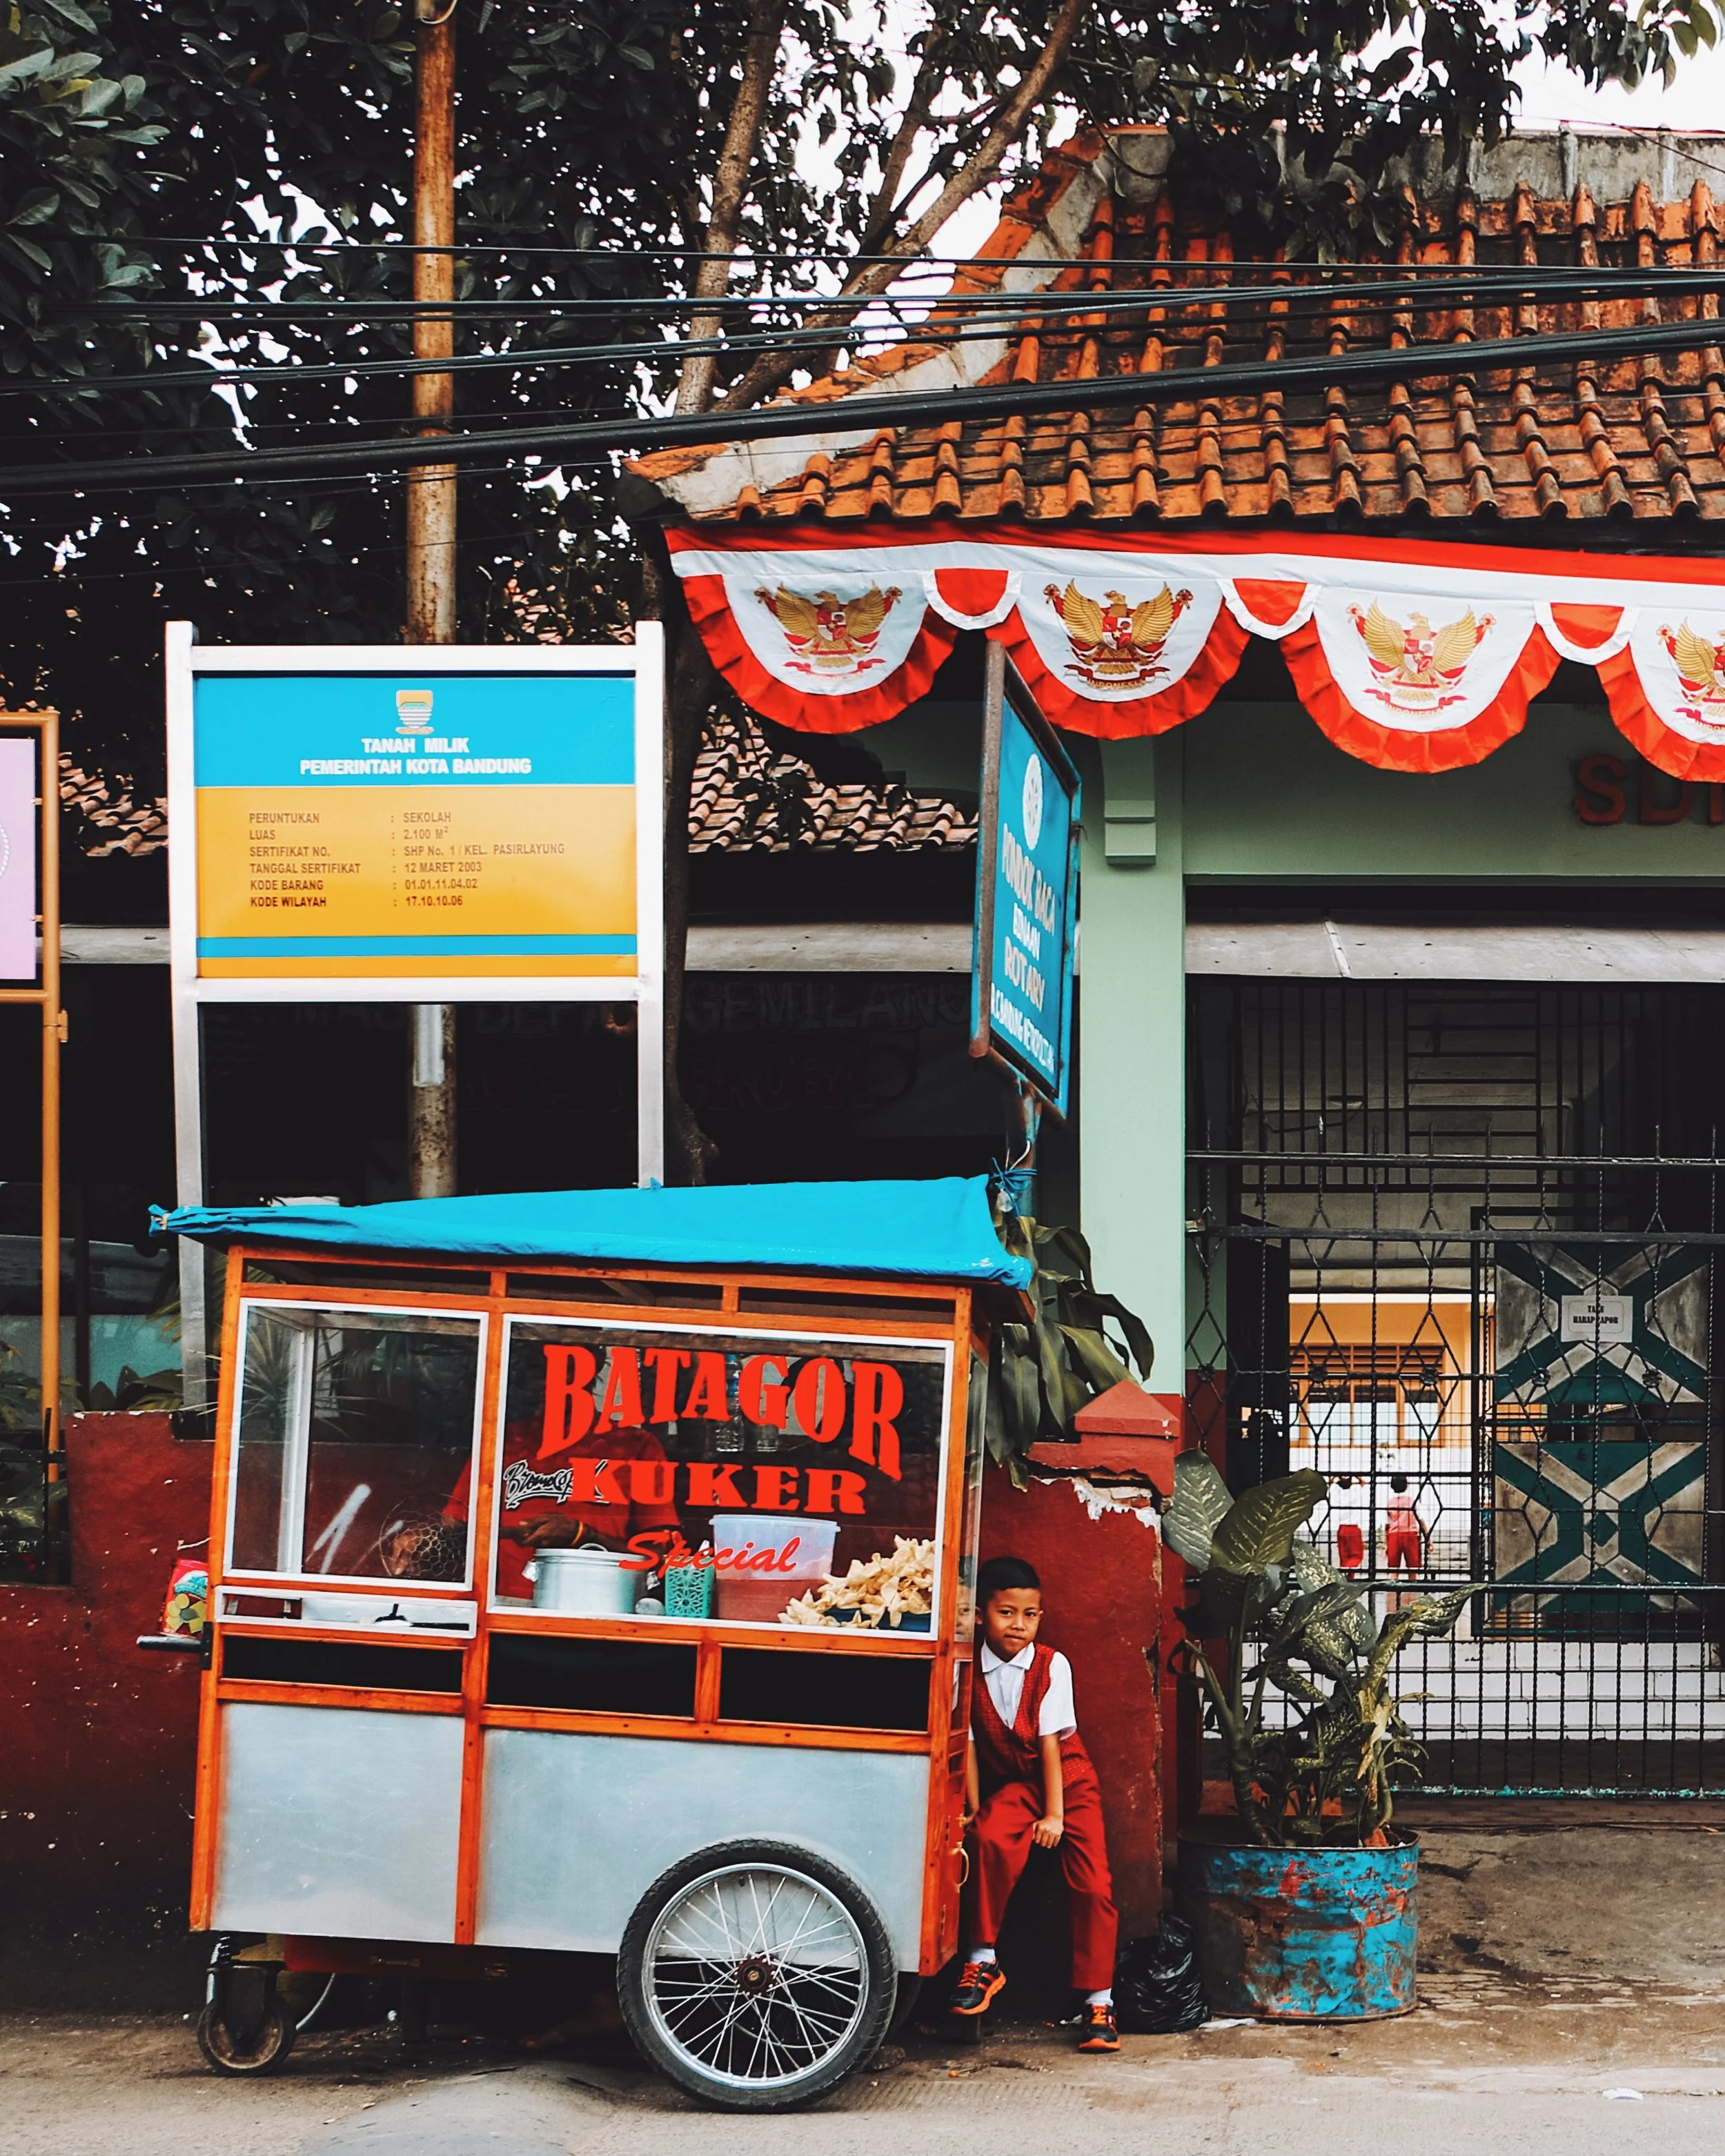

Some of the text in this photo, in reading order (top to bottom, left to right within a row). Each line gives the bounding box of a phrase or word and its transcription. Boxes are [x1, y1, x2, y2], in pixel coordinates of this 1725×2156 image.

[361, 738, 470, 753] TANAH MILIK
[300, 758, 532, 775] PEMERINTAH KOTA BANDUNG
[249, 813, 319, 824] PERUNTUKAN
[403, 812, 451, 823] SEKOLAH
[249, 829, 276, 840] LUAS
[404, 829, 431, 840] 2.100
[250, 847, 310, 858] SERTIFIKAT
[313, 847, 331, 857] NO.
[404, 846, 424, 856] SHP
[428, 845, 444, 856] No.
[450, 845, 455, 856] 1
[464, 844, 487, 856] KEL.
[493, 843, 565, 855] PASIRLAYUNG
[250, 863, 297, 874] TANGGAL
[302, 863, 361, 873] SERTIFIKAT
[404, 862, 416, 873] 12
[420, 862, 455, 873] MARET
[458, 862, 482, 872] 2003
[250, 880, 278, 891] KODE
[282, 880, 324, 891] BARANG
[405, 878, 478, 890] 01.01.11.04.02
[250, 897, 279, 907] KODE
[282, 896, 327, 907] WILAYAH
[406, 895, 464, 907] 17.10.10.06
[1005, 936, 1045, 1012] ROTARY
[536, 1344, 903, 1481] BATAGOR
[569, 1457, 867, 1514] KUKER
[619, 1529, 802, 1579] Special
